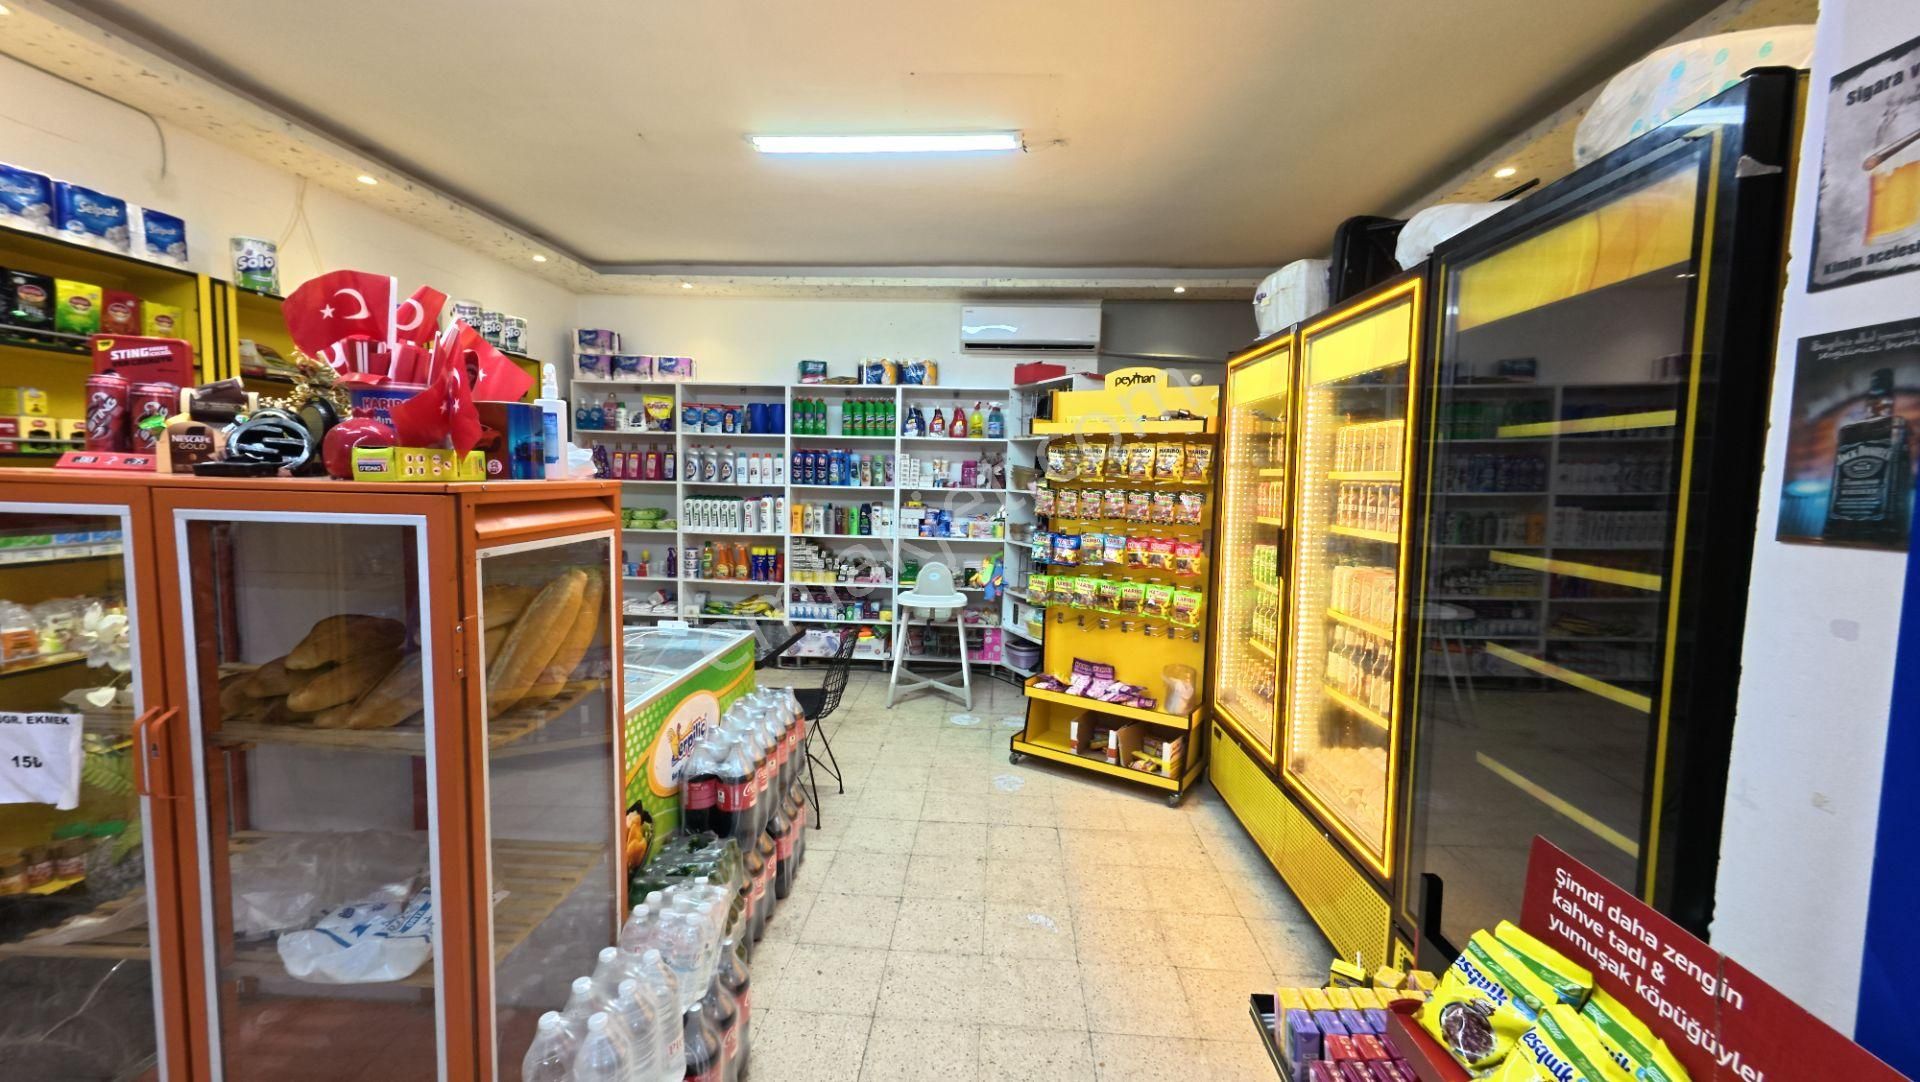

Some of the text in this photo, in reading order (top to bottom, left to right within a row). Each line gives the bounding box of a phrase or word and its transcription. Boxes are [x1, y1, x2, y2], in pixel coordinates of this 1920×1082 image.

[1846, 70, 1904, 106] Sigara
[77, 201, 119, 217] Selpak
[236, 254, 275, 272] Solo
[1823, 255, 1862, 276] Kimin
[504, 328, 520, 343] olo
[110, 347, 149, 359] STING
[1114, 372, 1156, 387] peyman
[362, 397, 411, 410] HARIB
[178, 443, 207, 451] GOLD
[26, 715, 70, 725] EKMEK
[1551, 888, 1667, 986] kahve tadı &
[1554, 866, 1745, 1011] Şimdi daha zengin
[1548, 913, 1632, 987] yumuşak
[1455, 955, 1508, 1006] esquik
